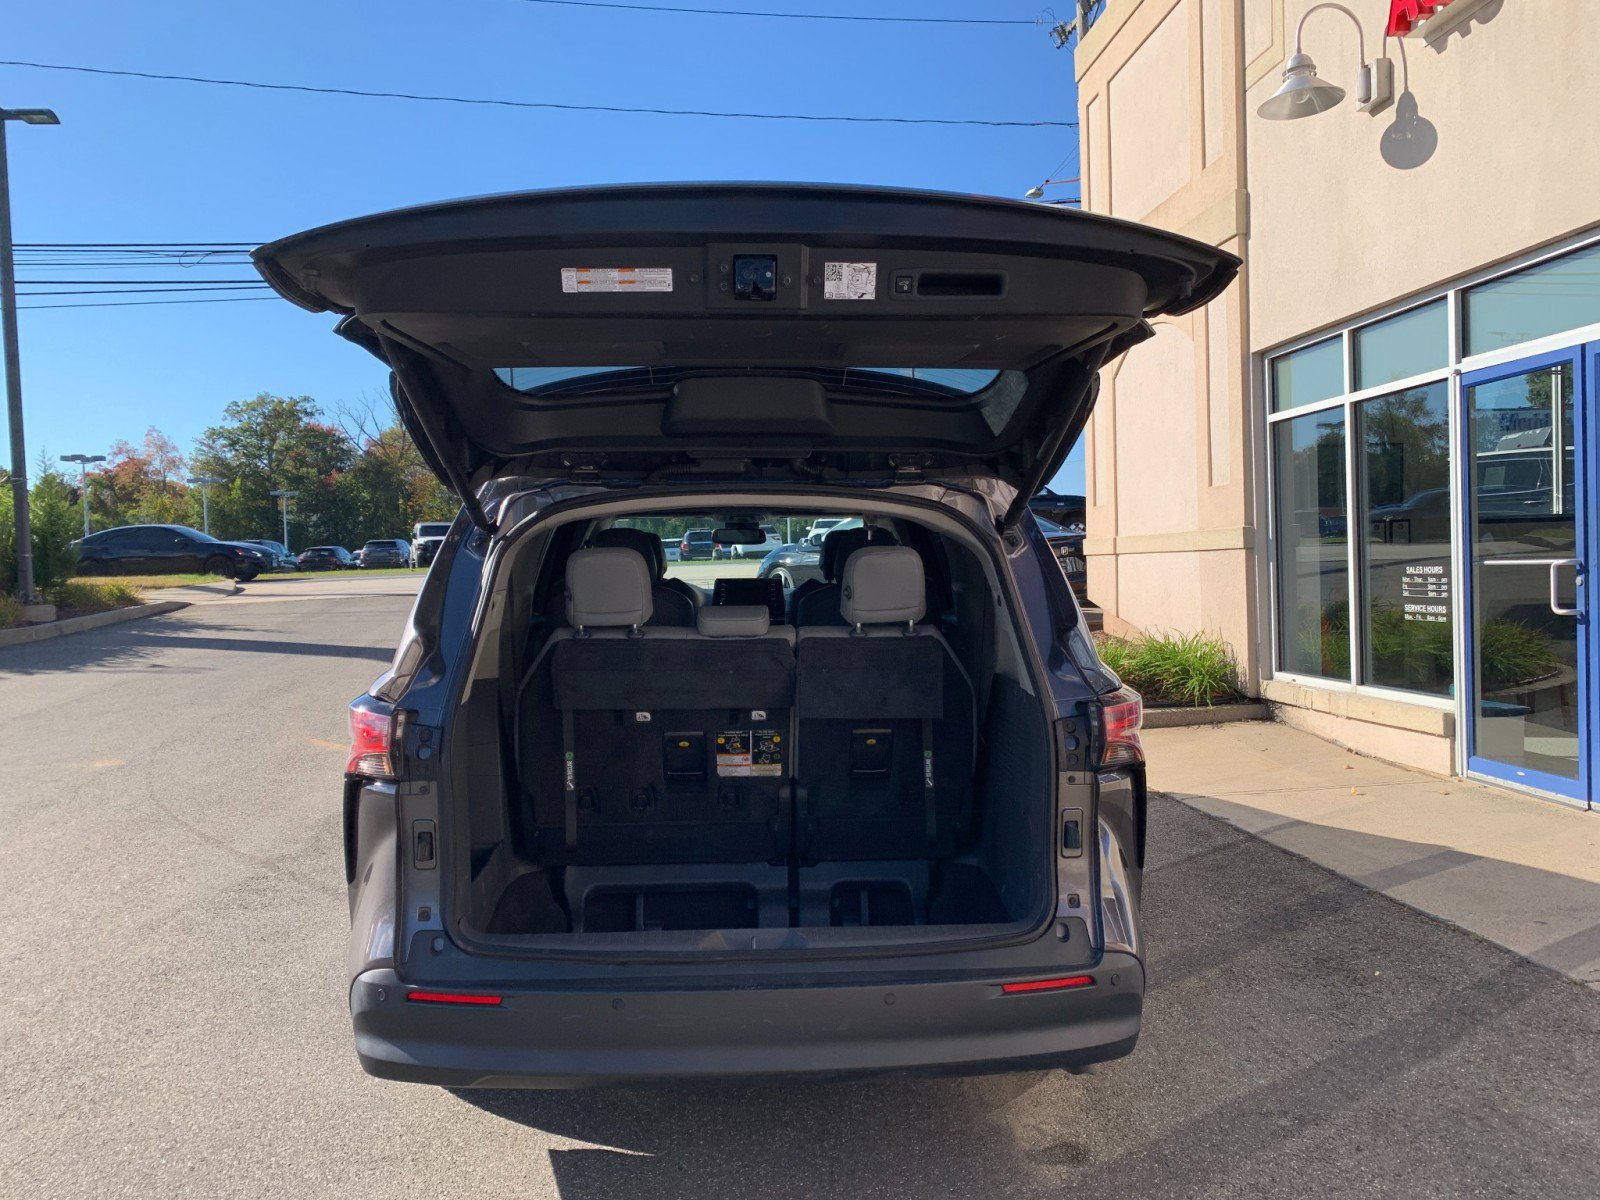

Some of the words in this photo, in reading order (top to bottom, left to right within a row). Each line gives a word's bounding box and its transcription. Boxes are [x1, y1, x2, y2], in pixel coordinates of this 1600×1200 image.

[1406, 566, 1422, 574] SALES
[1424, 566, 1443, 574] HOURS
[1404, 604, 1426, 612] SERVICE
[1427, 605, 1446, 613] HOURS
